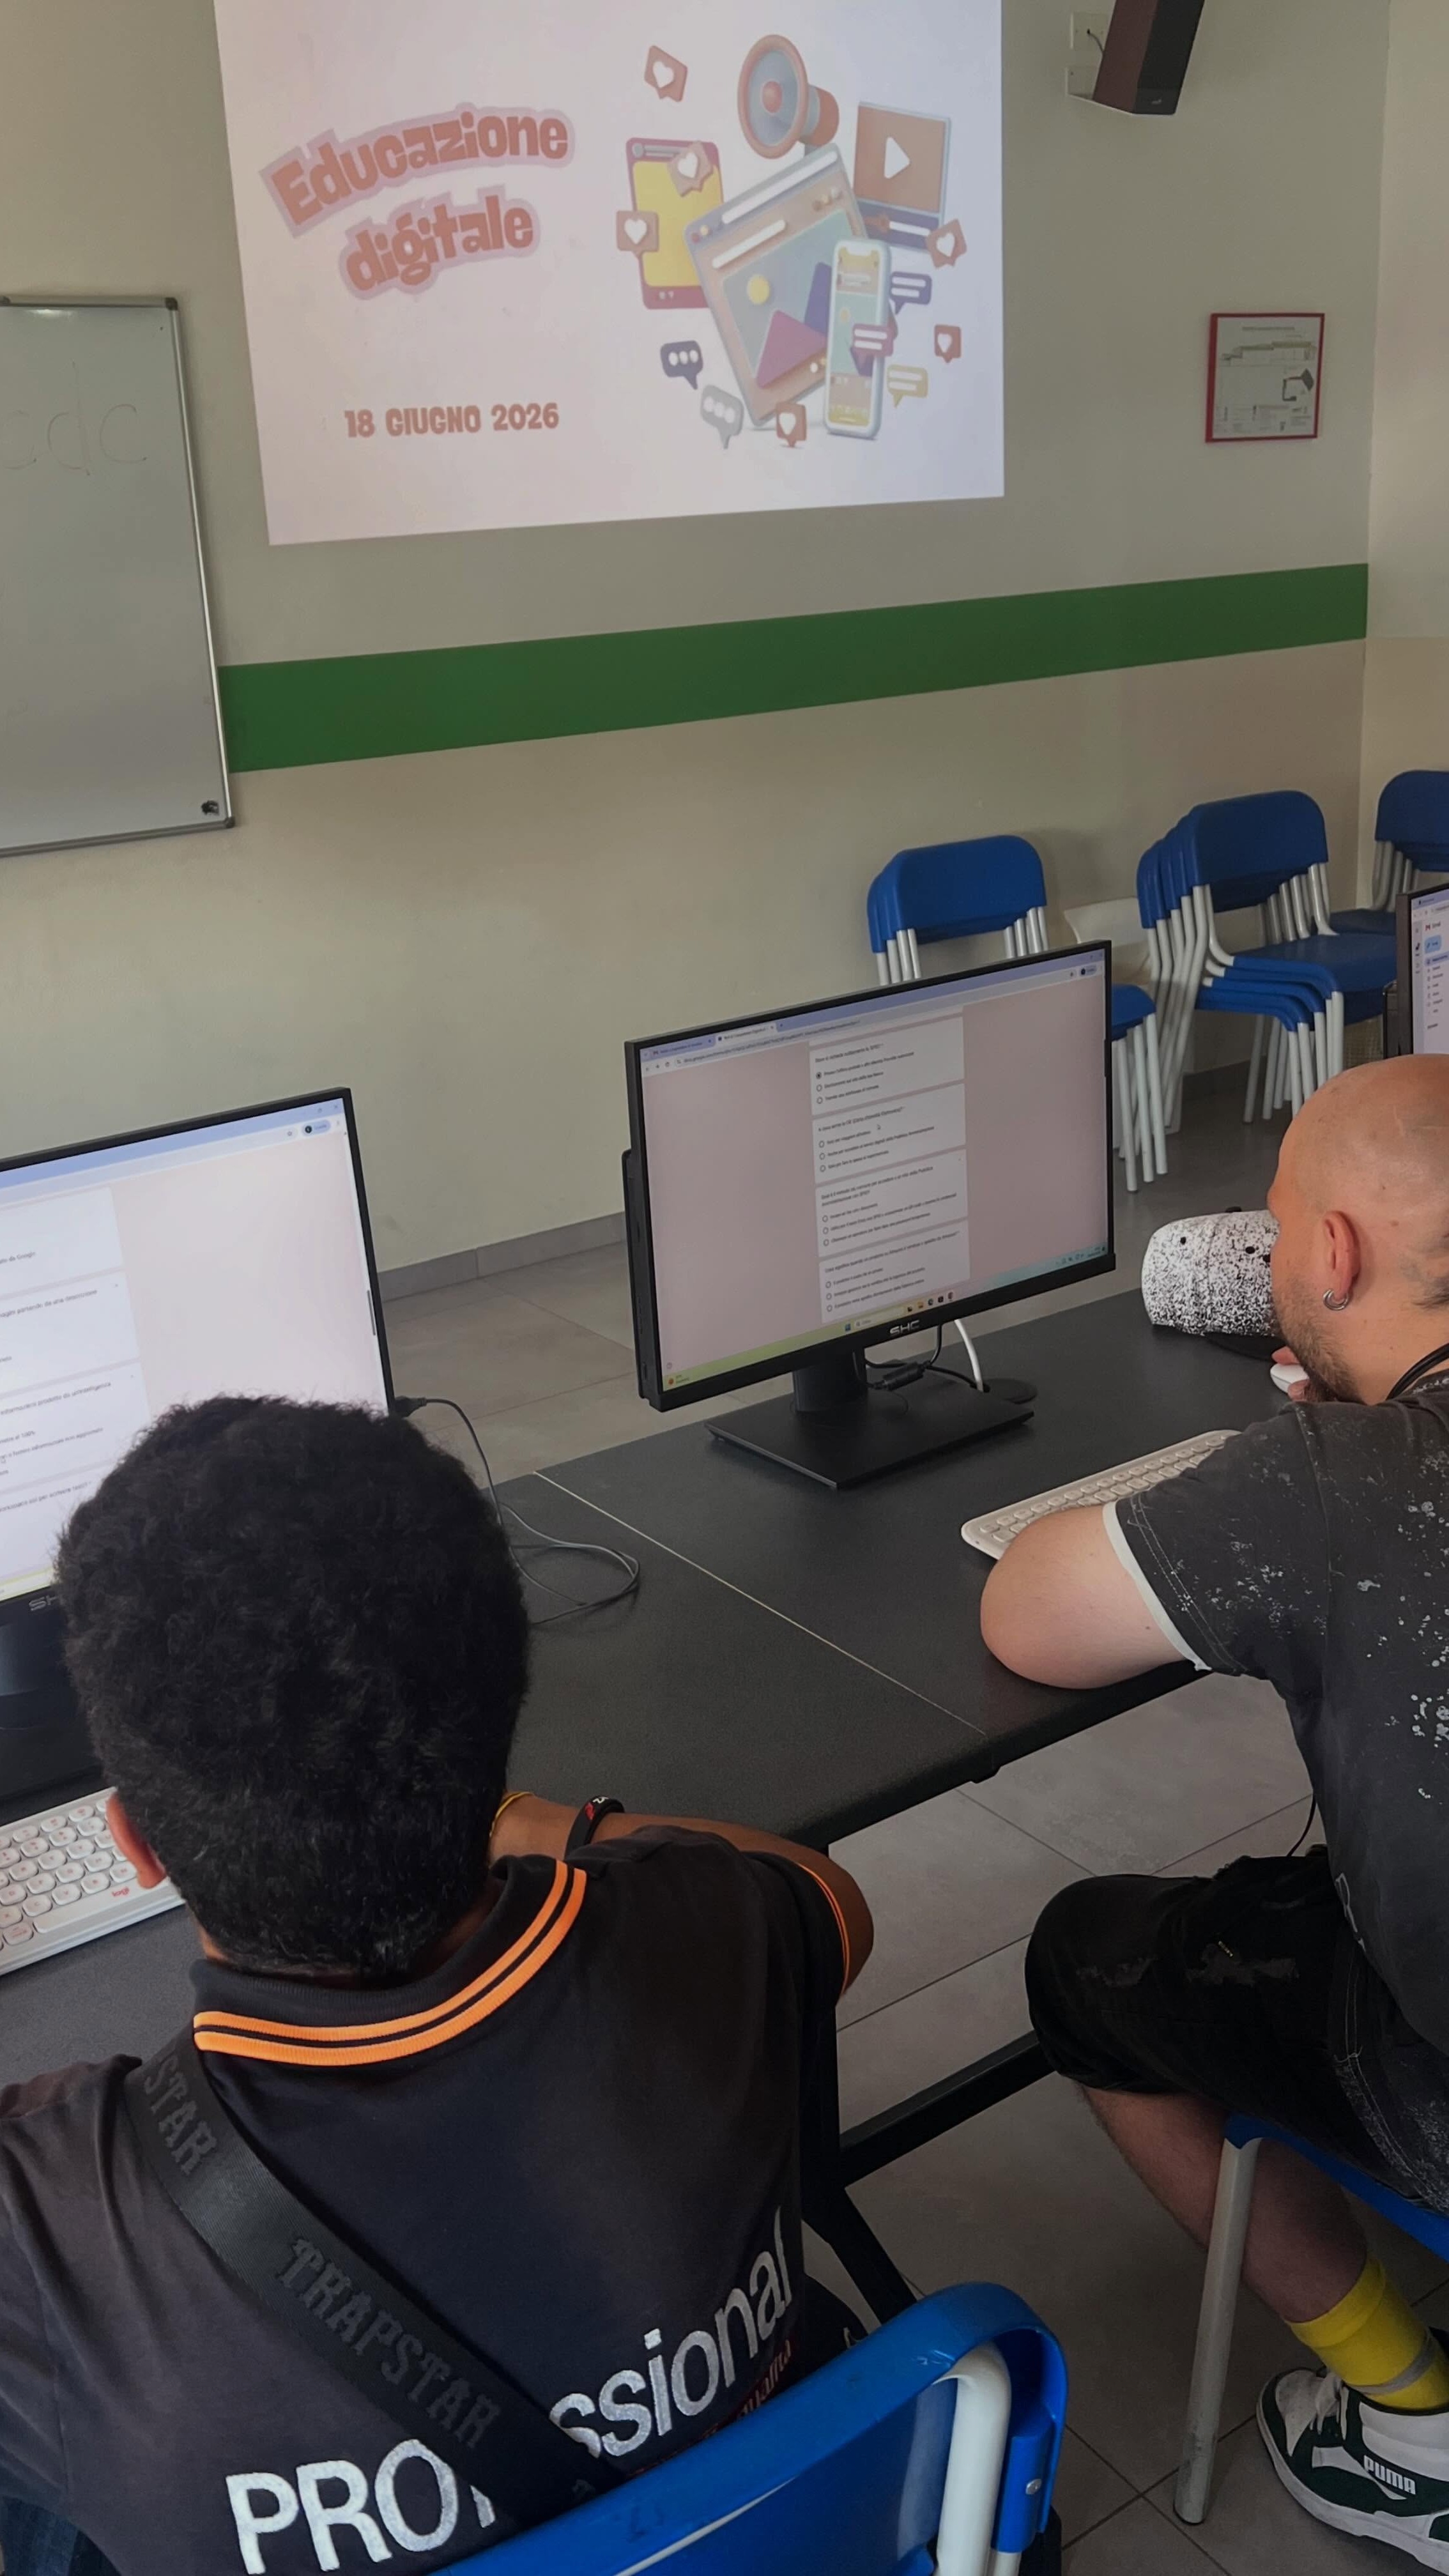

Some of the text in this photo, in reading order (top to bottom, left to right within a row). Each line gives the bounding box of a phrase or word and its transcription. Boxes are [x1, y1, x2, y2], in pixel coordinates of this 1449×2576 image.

[270, 111, 568, 226] Educazione
[346, 195, 533, 293] digitale
[344, 402, 560, 438] 18 GIUGNO 2026
[278, 2238, 501, 2449] TRAPSTAR
[1363, 2455, 1416, 2495] PUMA
